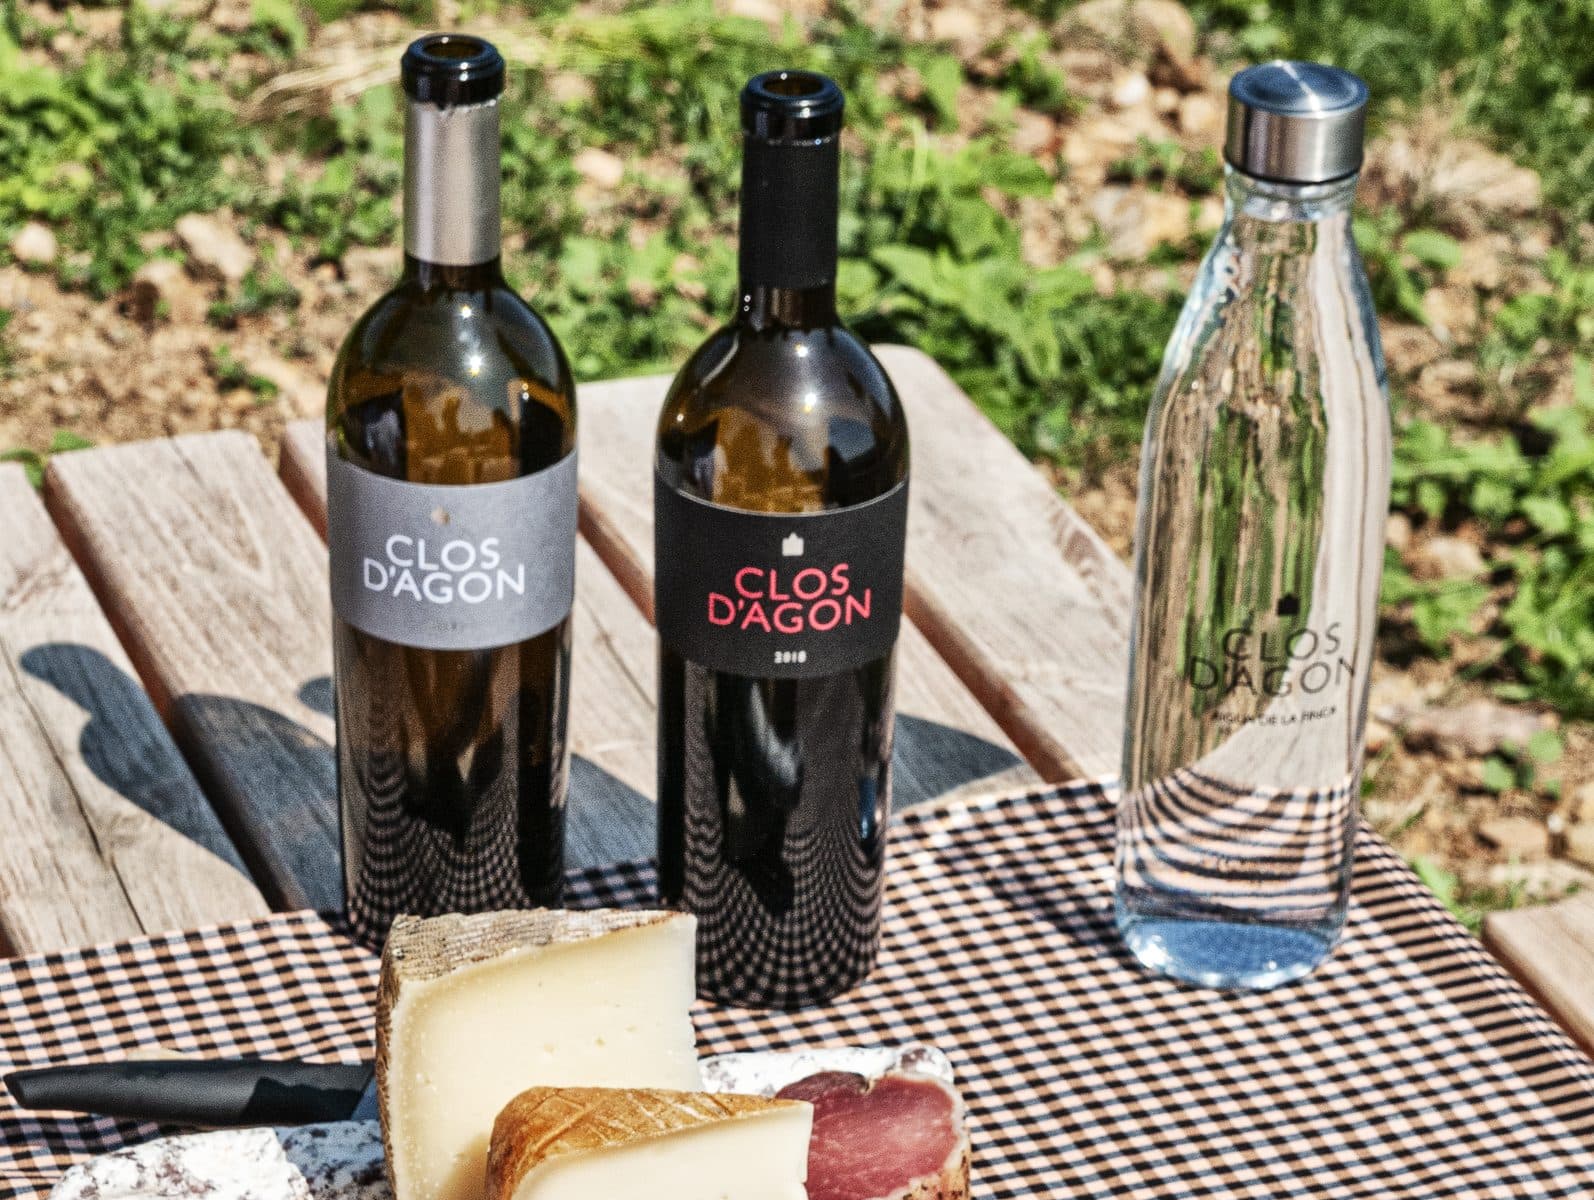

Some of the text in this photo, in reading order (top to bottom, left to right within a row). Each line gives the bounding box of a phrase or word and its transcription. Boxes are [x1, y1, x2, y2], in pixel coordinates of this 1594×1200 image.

[385, 534, 500, 572] CLOS
[363, 557, 525, 604] D'AGON
[735, 563, 850, 600] CLOS
[708, 588, 872, 634] D'AGON
[1222, 621, 1342, 661] CLOS
